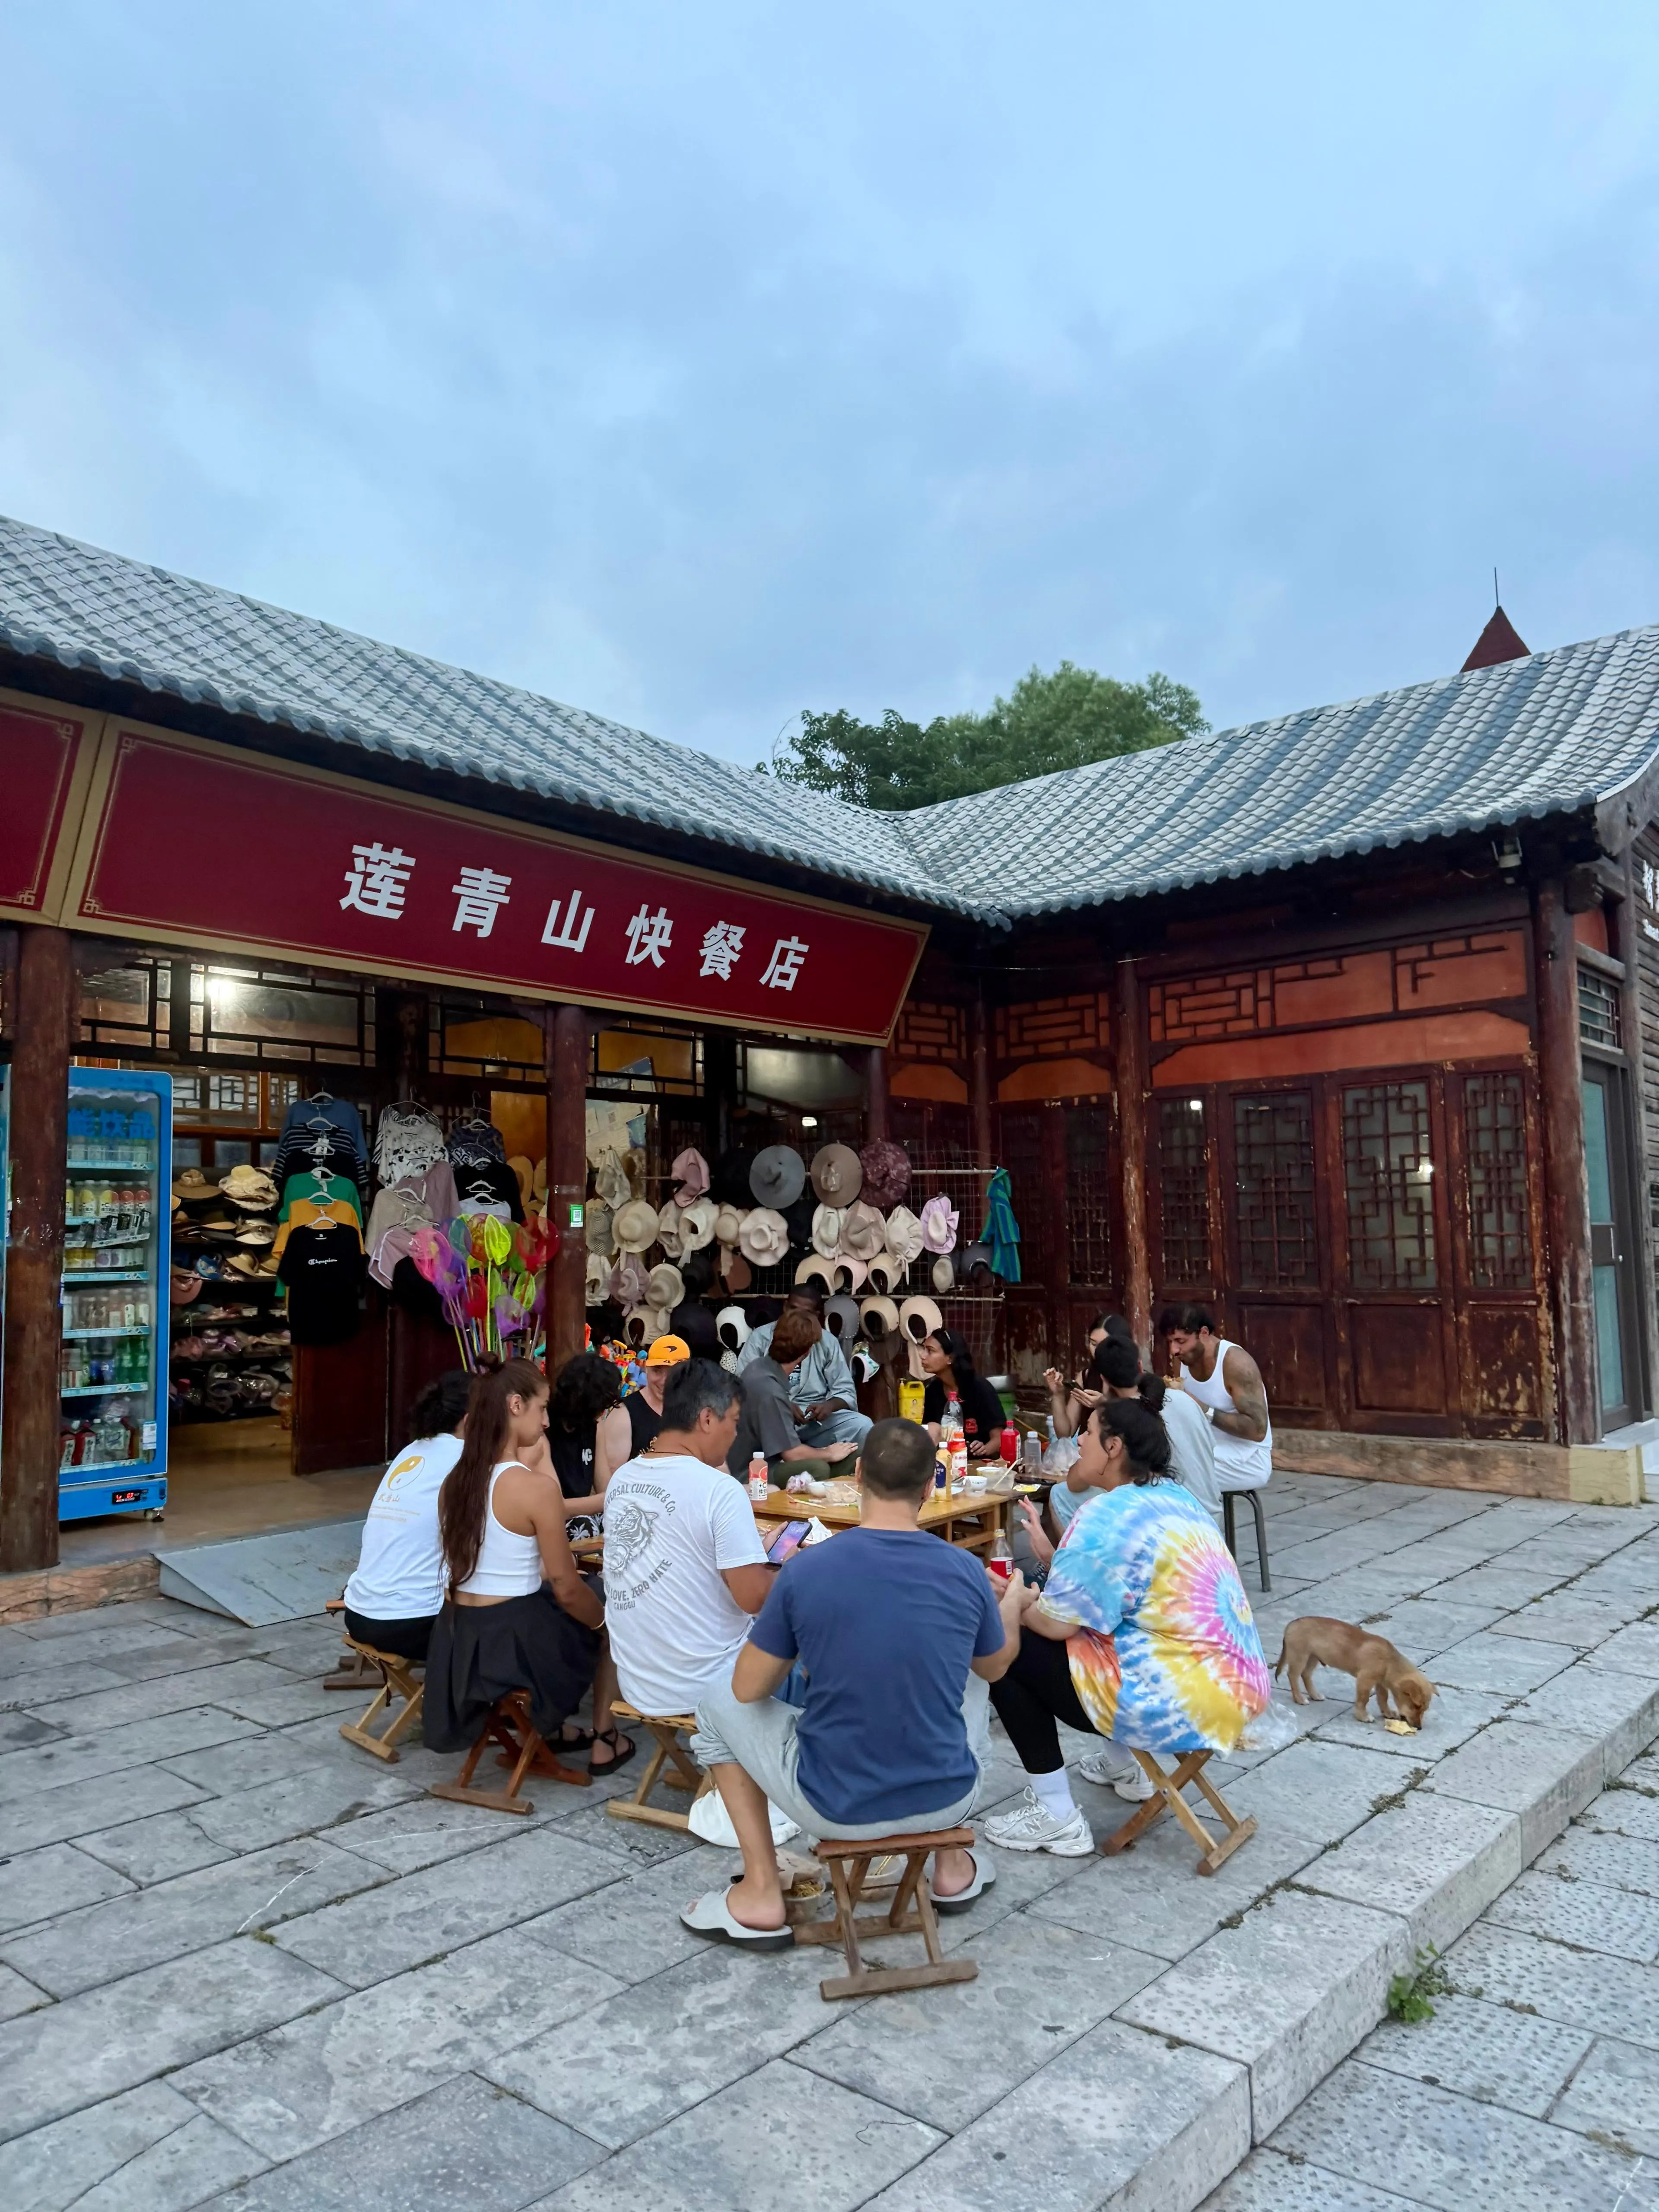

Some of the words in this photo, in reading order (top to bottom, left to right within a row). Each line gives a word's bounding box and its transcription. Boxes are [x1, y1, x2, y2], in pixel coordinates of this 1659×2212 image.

[339, 842, 809, 991] 莲青山快餐店
[631, 1483, 665, 1498] CULTURE
[661, 1493, 671, 1503] &
[665, 1500, 676, 1516] CO.
[610, 1587, 629, 1601] LOVE,
[630, 1580, 650, 1599] ZERO
[648, 1559, 672, 1583] HATE
[1023, 1818, 1042, 1836] N
